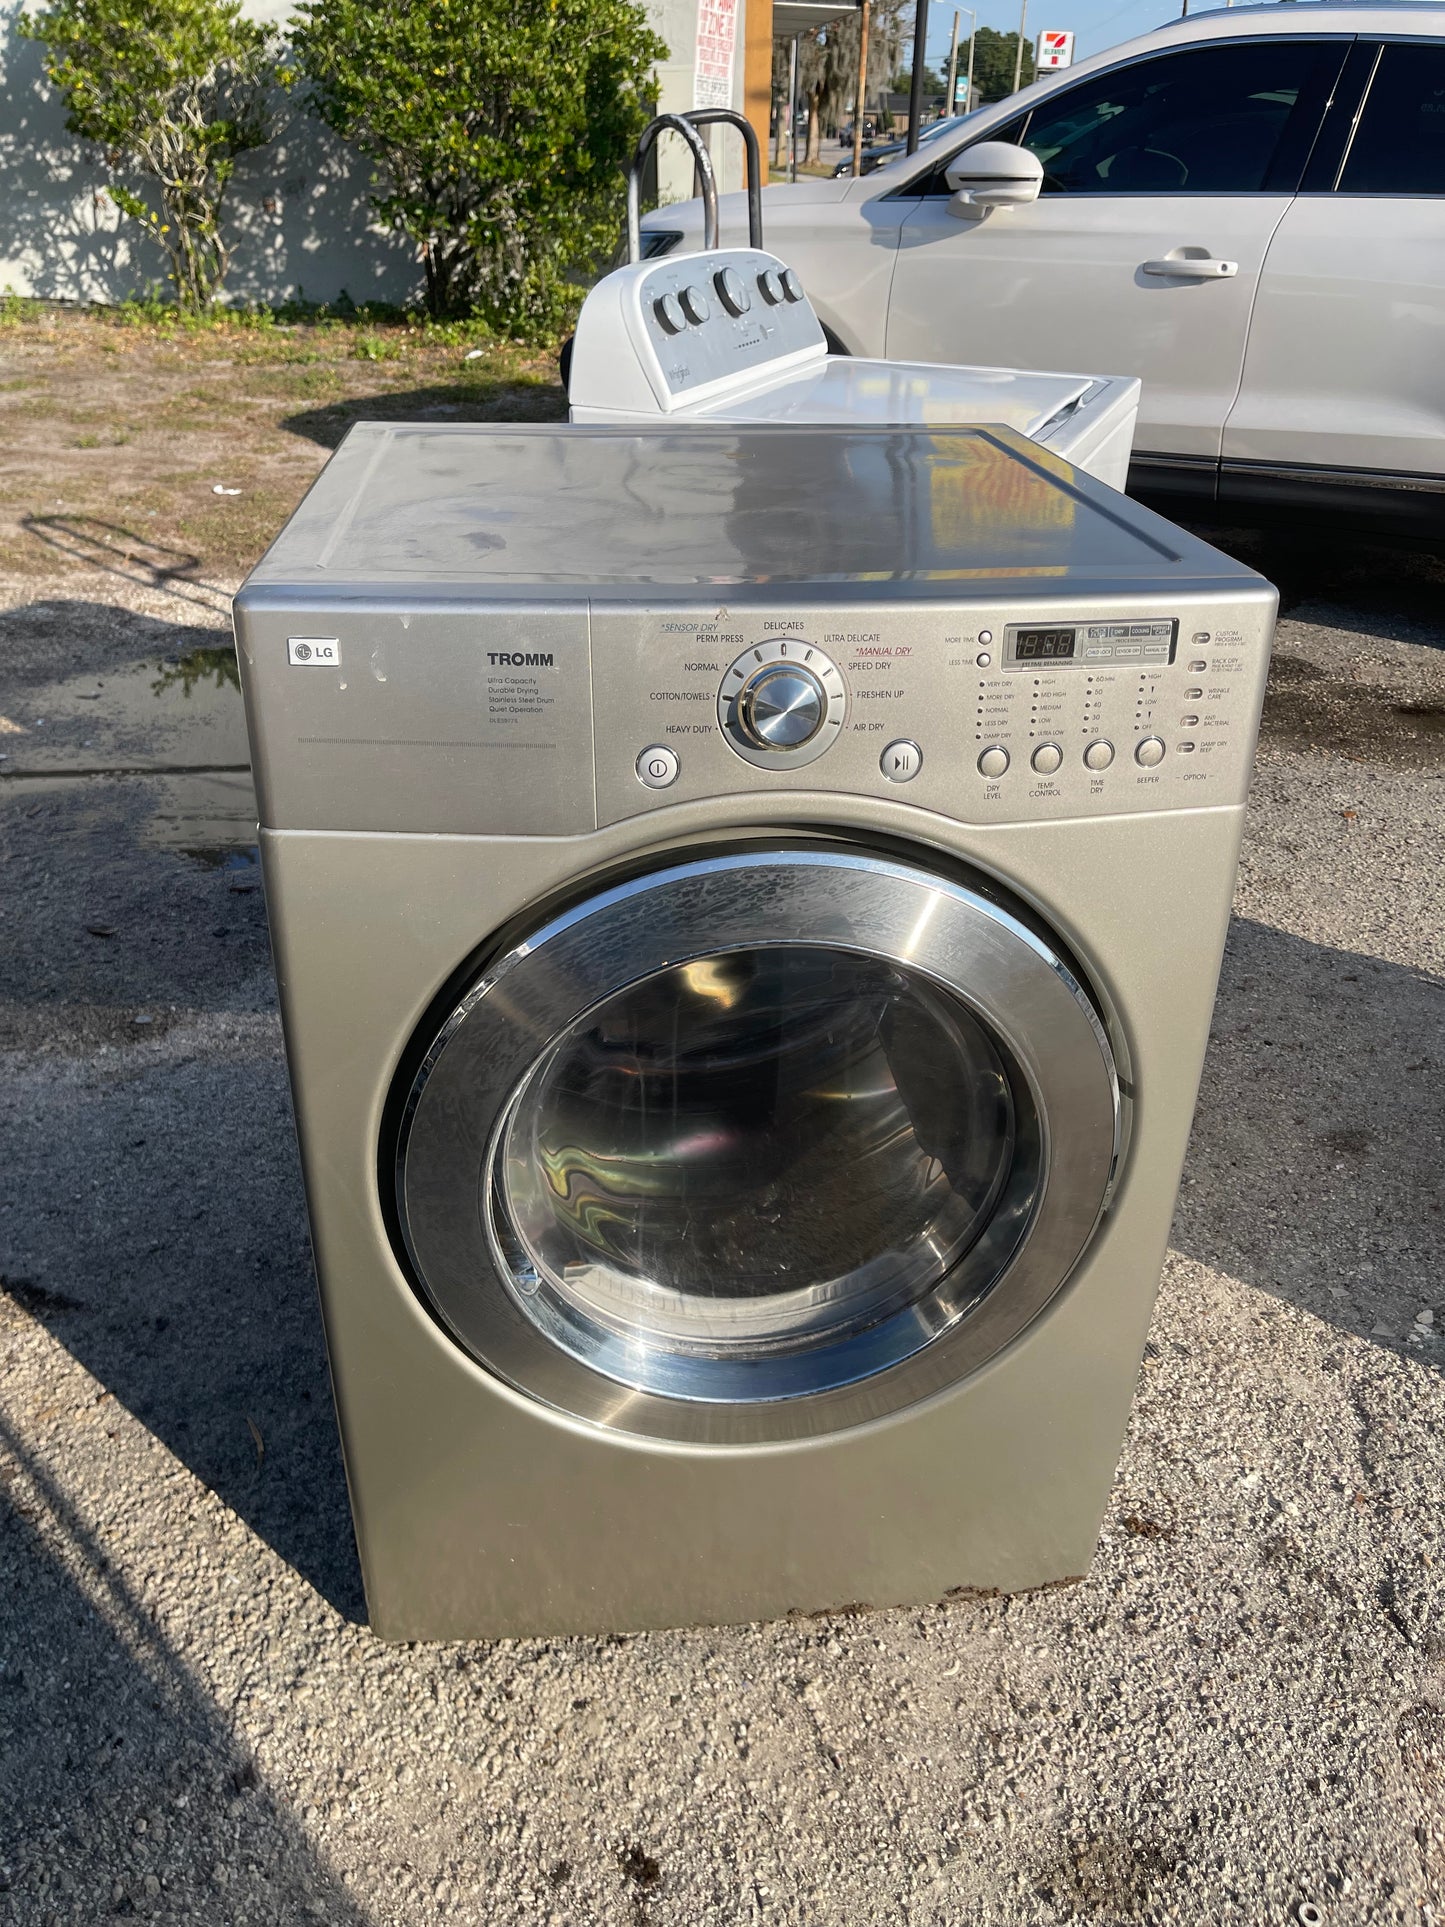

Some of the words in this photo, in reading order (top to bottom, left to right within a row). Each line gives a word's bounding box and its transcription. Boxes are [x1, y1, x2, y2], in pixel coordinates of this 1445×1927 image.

[700, 623, 719, 632] DRY
[763, 621, 805, 630] DELICATES
[696, 634, 718, 643] PERM
[720, 634, 744, 643] PRESS
[823, 633, 845, 643] ULTRA
[847, 633, 881, 642] DELICATE
[315, 647, 333, 658] LG
[894, 646, 912, 655] DRY
[487, 652, 554, 666] TROMM
[684, 663, 720, 672] NORMAL
[848, 662, 873, 670] SPEED
[875, 662, 892, 670] DRY
[504, 677, 537, 685] Capacity
[517, 687, 539, 695] Drying
[856, 690, 892, 698] FRESHEN
[893, 690, 905, 698] UP
[650, 692, 710, 701] COTTON/TOWELS
[489, 705, 508, 713] Quiet
[665, 725, 691, 734] HEAVY
[692, 725, 713, 734] DUTY
[853, 723, 867, 731] AIR
[868, 723, 885, 731] DRY
[1136, 776, 1160, 784] BEEPER
[1183, 773, 1207, 781] OPTION
[1037, 781, 1055, 789] TEMP
[1028, 789, 1061, 798] CONTROL
